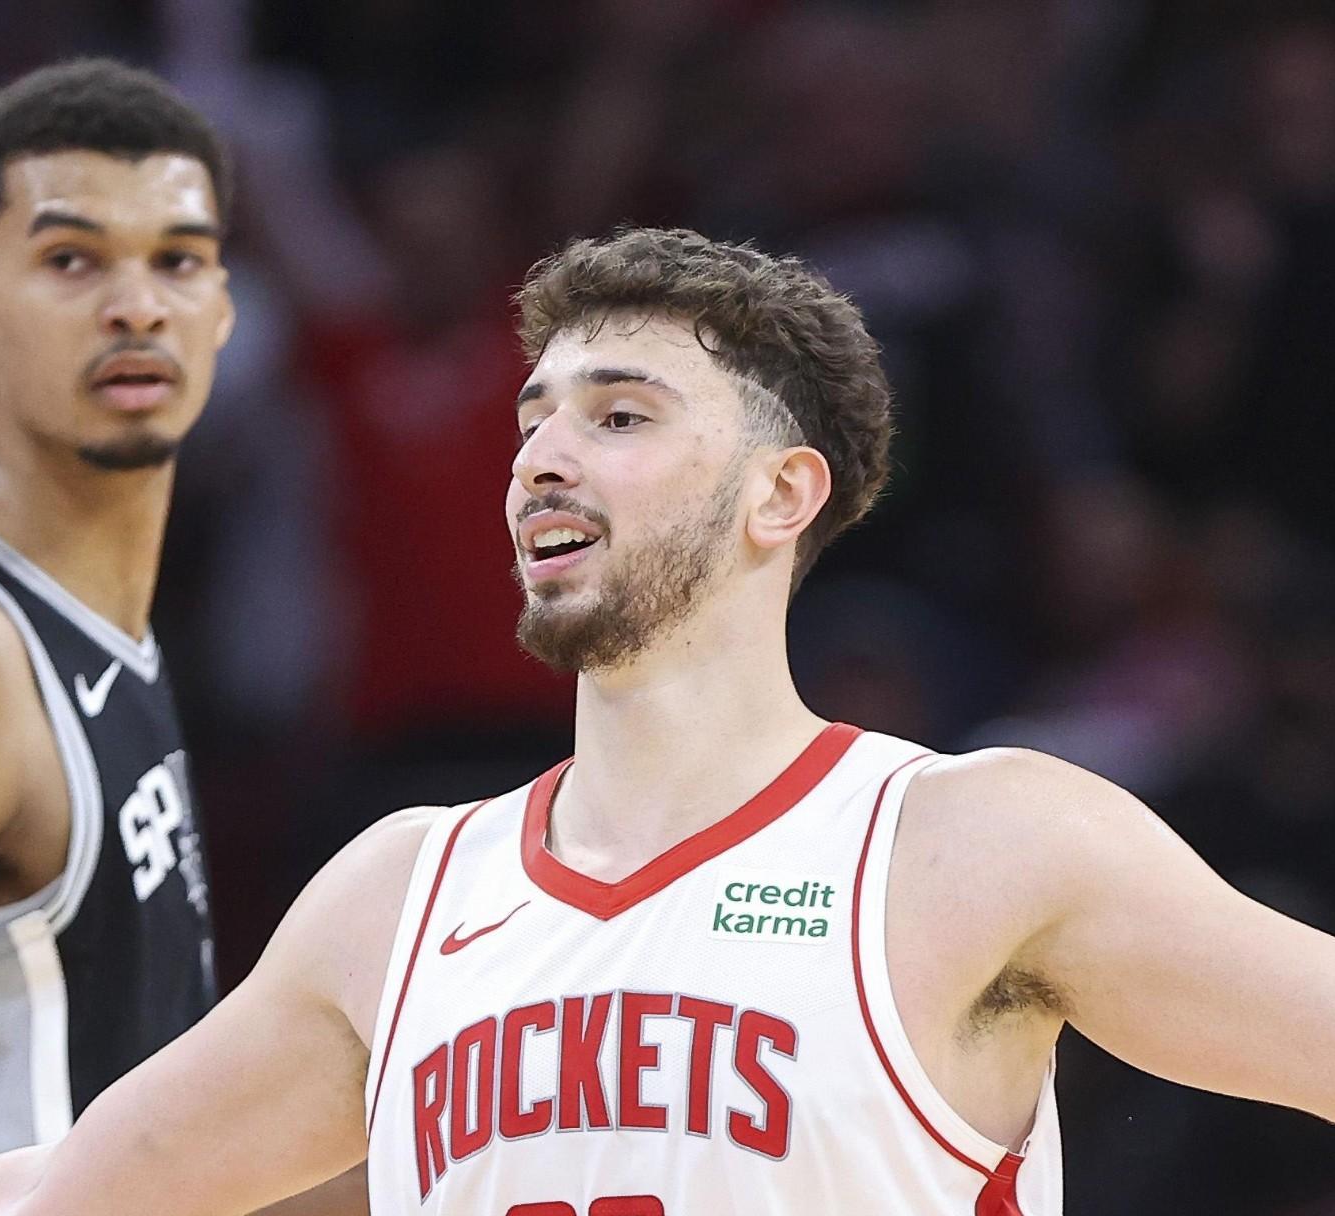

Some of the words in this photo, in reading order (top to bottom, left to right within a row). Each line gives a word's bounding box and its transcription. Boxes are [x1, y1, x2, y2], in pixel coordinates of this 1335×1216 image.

[725, 881, 835, 908] credit
[712, 903, 828, 937] karma
[413, 988, 800, 1205] ROCKETS
